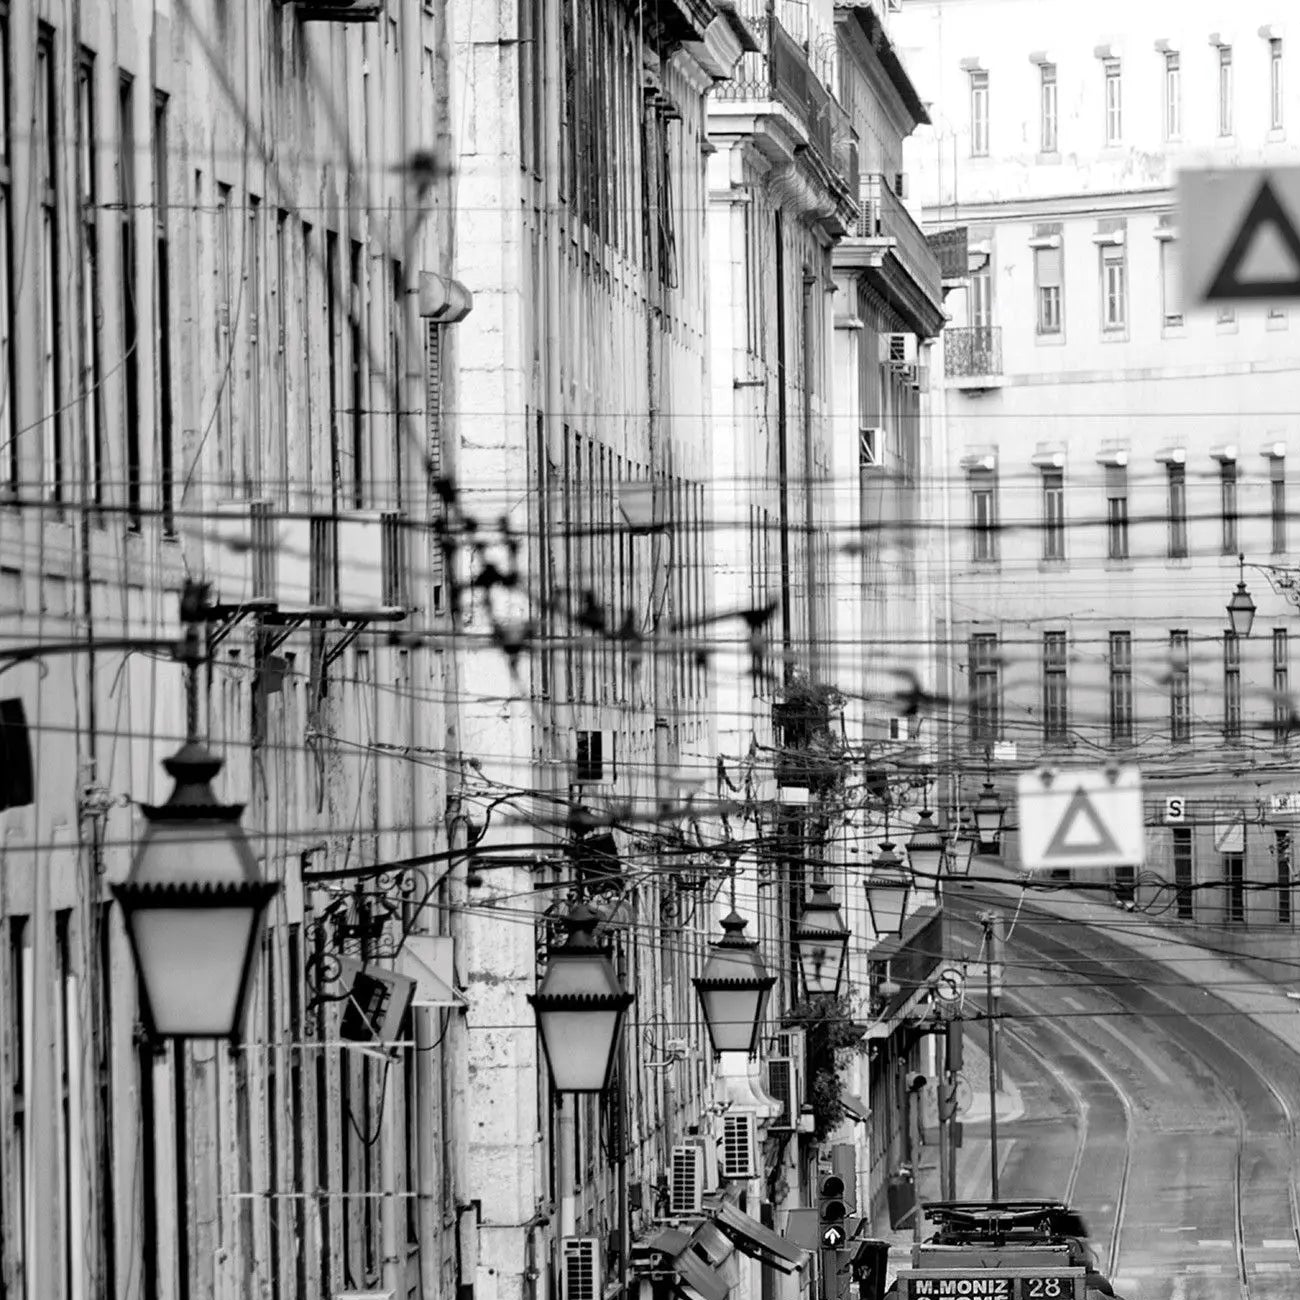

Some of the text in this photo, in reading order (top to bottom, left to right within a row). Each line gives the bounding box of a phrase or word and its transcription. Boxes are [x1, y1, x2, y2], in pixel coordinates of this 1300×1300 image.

[1169, 799, 1182, 818] S
[915, 1279, 1009, 1294] M.MONIZ
[1028, 1278, 1061, 1297] 28
